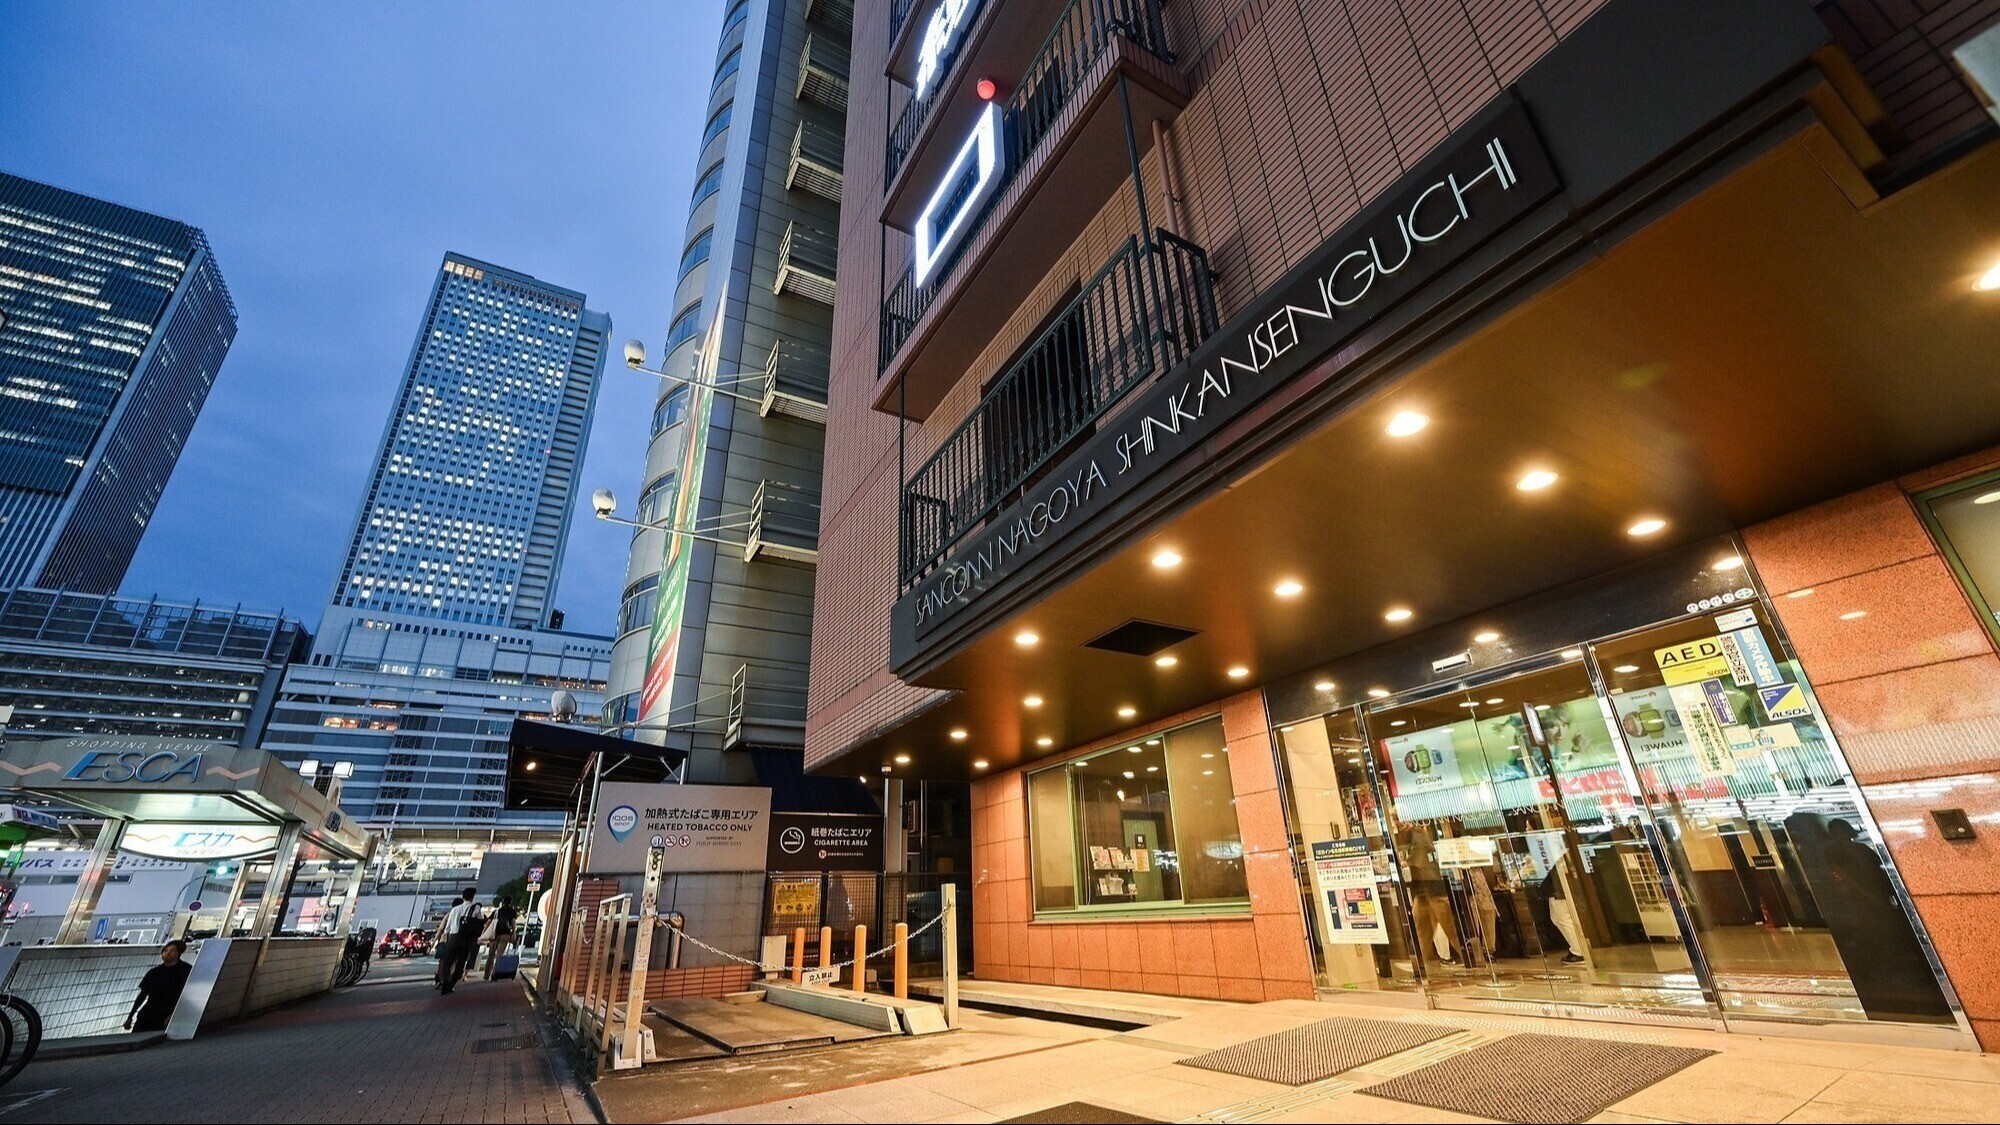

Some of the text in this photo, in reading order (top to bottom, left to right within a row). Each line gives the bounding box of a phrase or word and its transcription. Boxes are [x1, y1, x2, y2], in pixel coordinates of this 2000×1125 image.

[998, 459, 1107, 566] NAGOYA
[1115, 137, 1517, 475] SHINKANSENGUCHI
[1661, 642, 1717, 666] AED
[1772, 707, 1808, 719] ALSOK
[67, 739, 213, 752] SHOPPING AVENUE
[62, 750, 204, 784] ESCA
[644, 807, 759, 821] 加熱式たばこ専用エリア
[647, 823, 753, 832] HEATED TOBACCO ONLY
[811, 827, 872, 838] 紙巻たばこエリア
[174, 832, 236, 847] エスカ
[814, 838, 868, 847] CIGARETTE AREA
